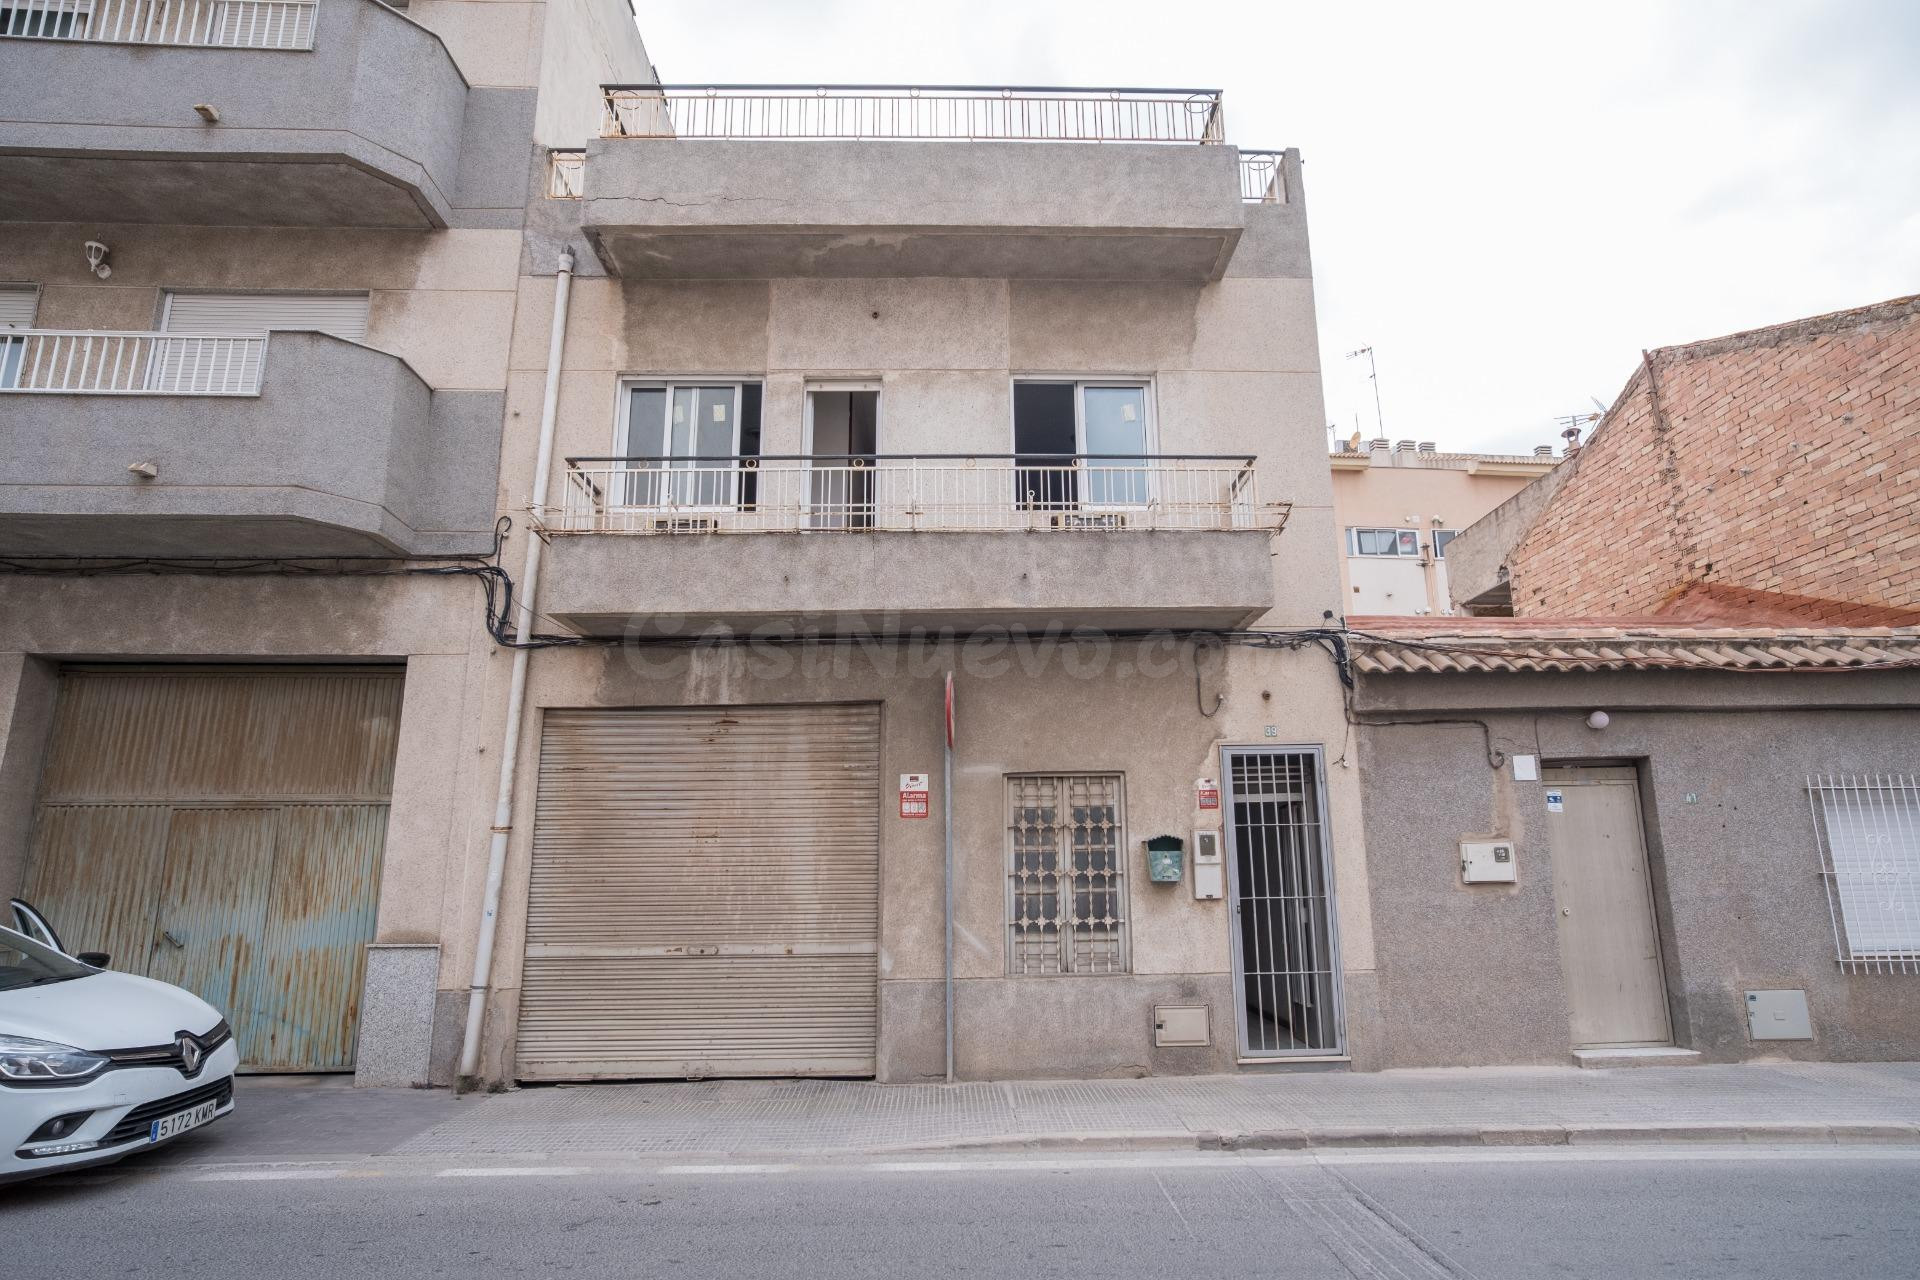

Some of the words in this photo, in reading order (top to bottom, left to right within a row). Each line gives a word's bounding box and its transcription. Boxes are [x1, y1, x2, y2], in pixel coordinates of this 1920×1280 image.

[1265, 726, 1277, 737] 39
[160, 1112, 192, 1136] 5172
[194, 1103, 214, 1124] KMR
